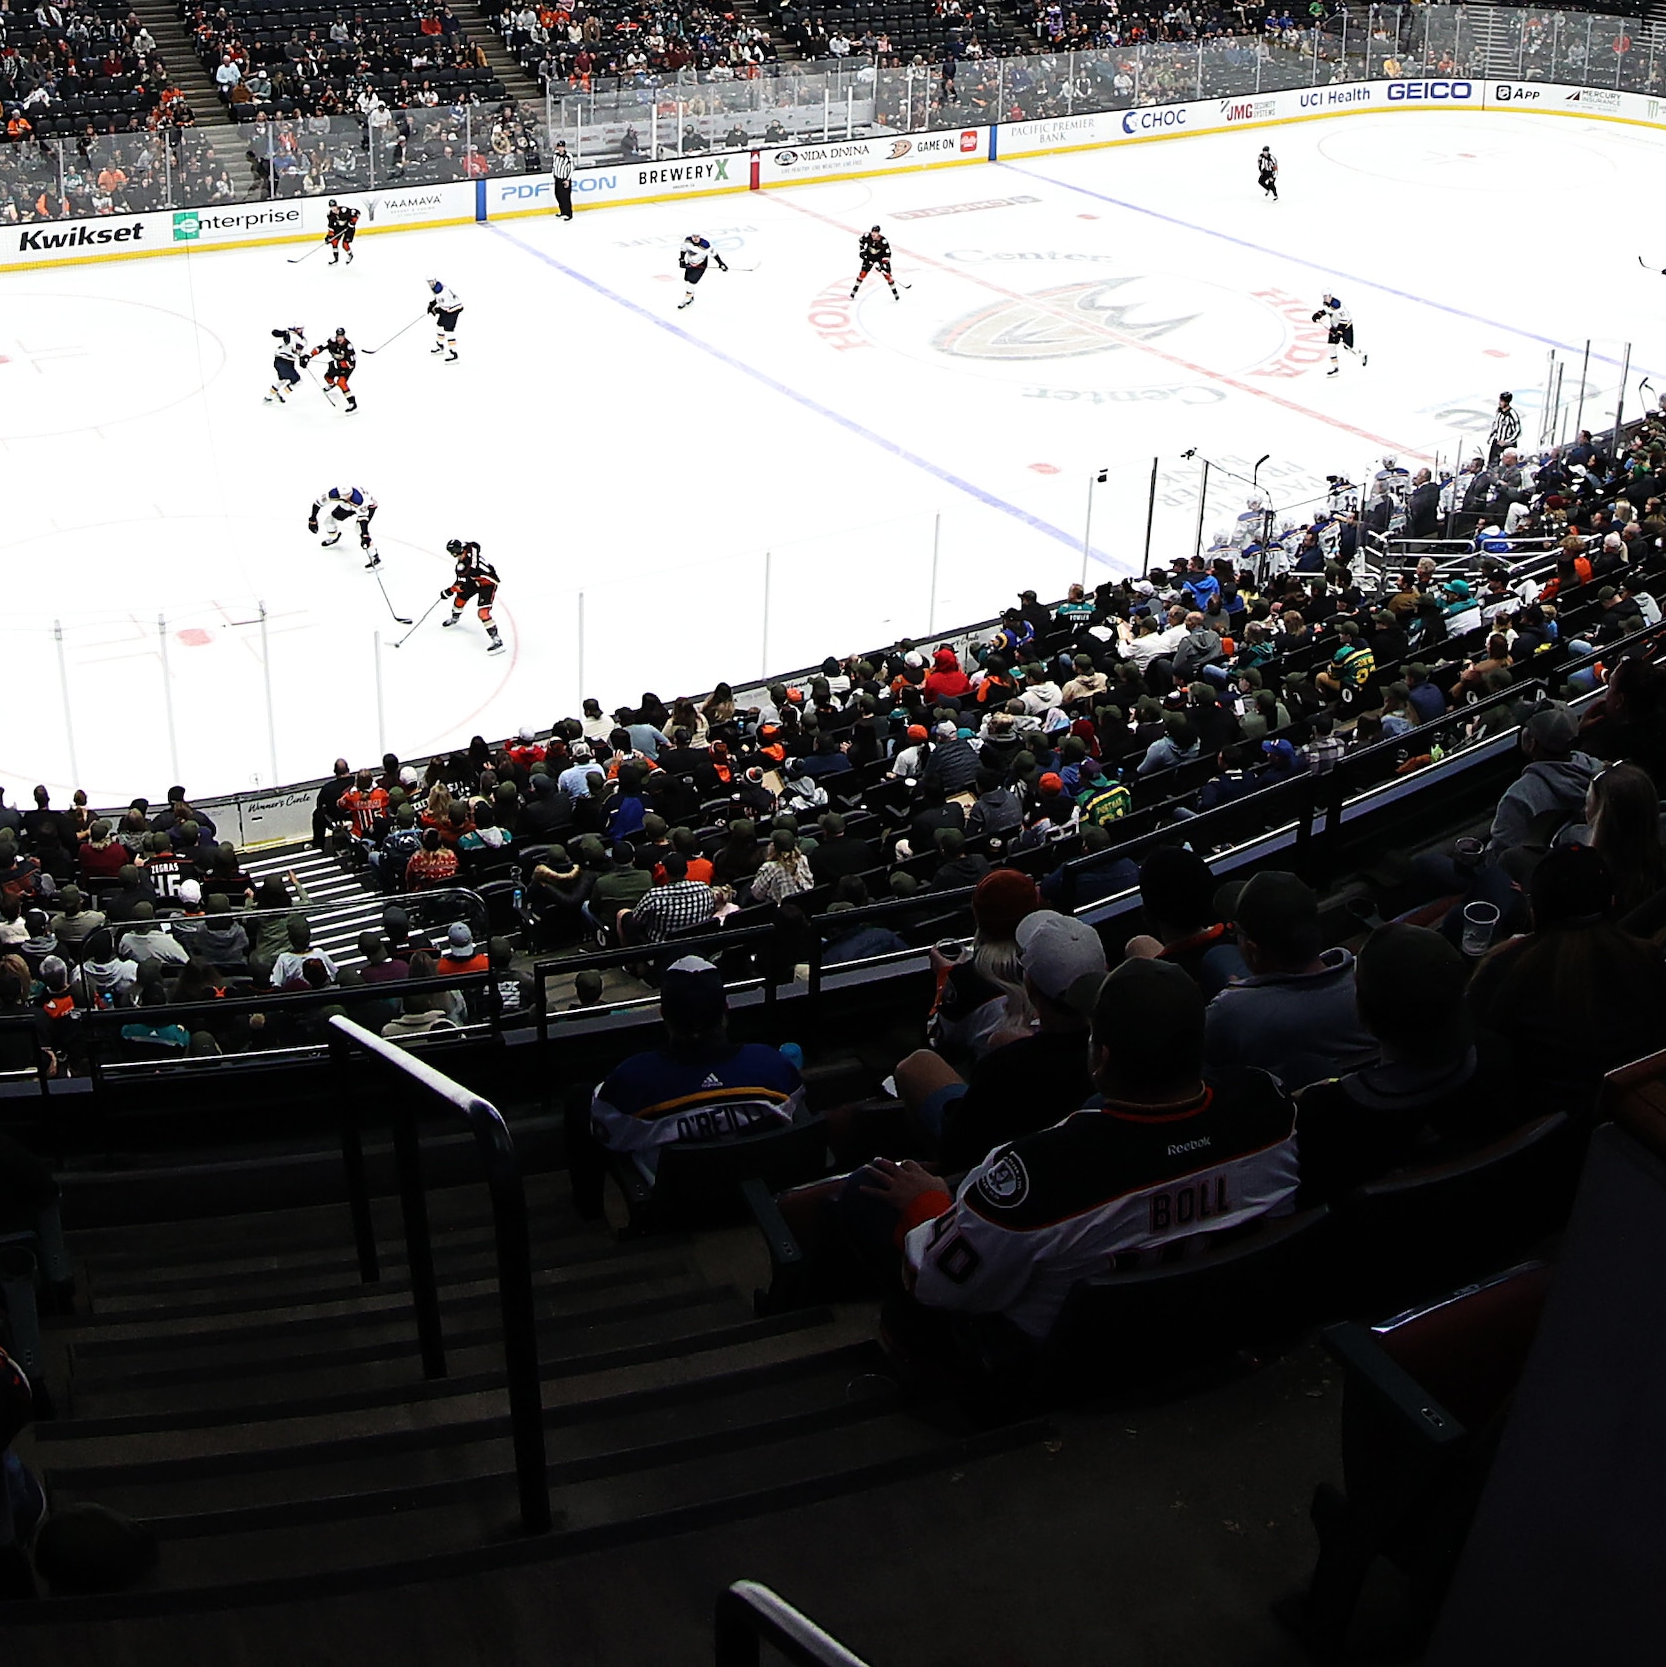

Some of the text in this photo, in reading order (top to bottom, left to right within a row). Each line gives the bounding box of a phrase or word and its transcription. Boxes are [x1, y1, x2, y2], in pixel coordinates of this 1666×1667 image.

[1300, 87, 1370, 107] UCI Health
[1387, 81, 1471, 100] GEICO
[1582, 90, 1621, 100] MERCURY
[1227, 103, 1253, 121] JMG
[1254, 100, 1276, 109] SECURITY
[1011, 119, 1094, 137] PACIFIC PREMIER
[1141, 110, 1186, 129] CHOC
[918, 139, 954, 153] GAME ON
[1039, 133, 1066, 145] BANK
[800, 144, 870, 161] VIDA DIVINA
[639, 163, 714, 185] BREWERY
[179, 209, 300, 234] enterprise
[18, 221, 145, 251] Kwikset
[944, 249, 1112, 263] Center
[1021, 386, 1227, 405] Center
[248, 793, 311, 814] Winner's Circle
[151, 863, 179, 875] ZEGRAS
[1167, 1135, 1211, 1156] Reebok
[1150, 1174, 1229, 1233] BOLL
